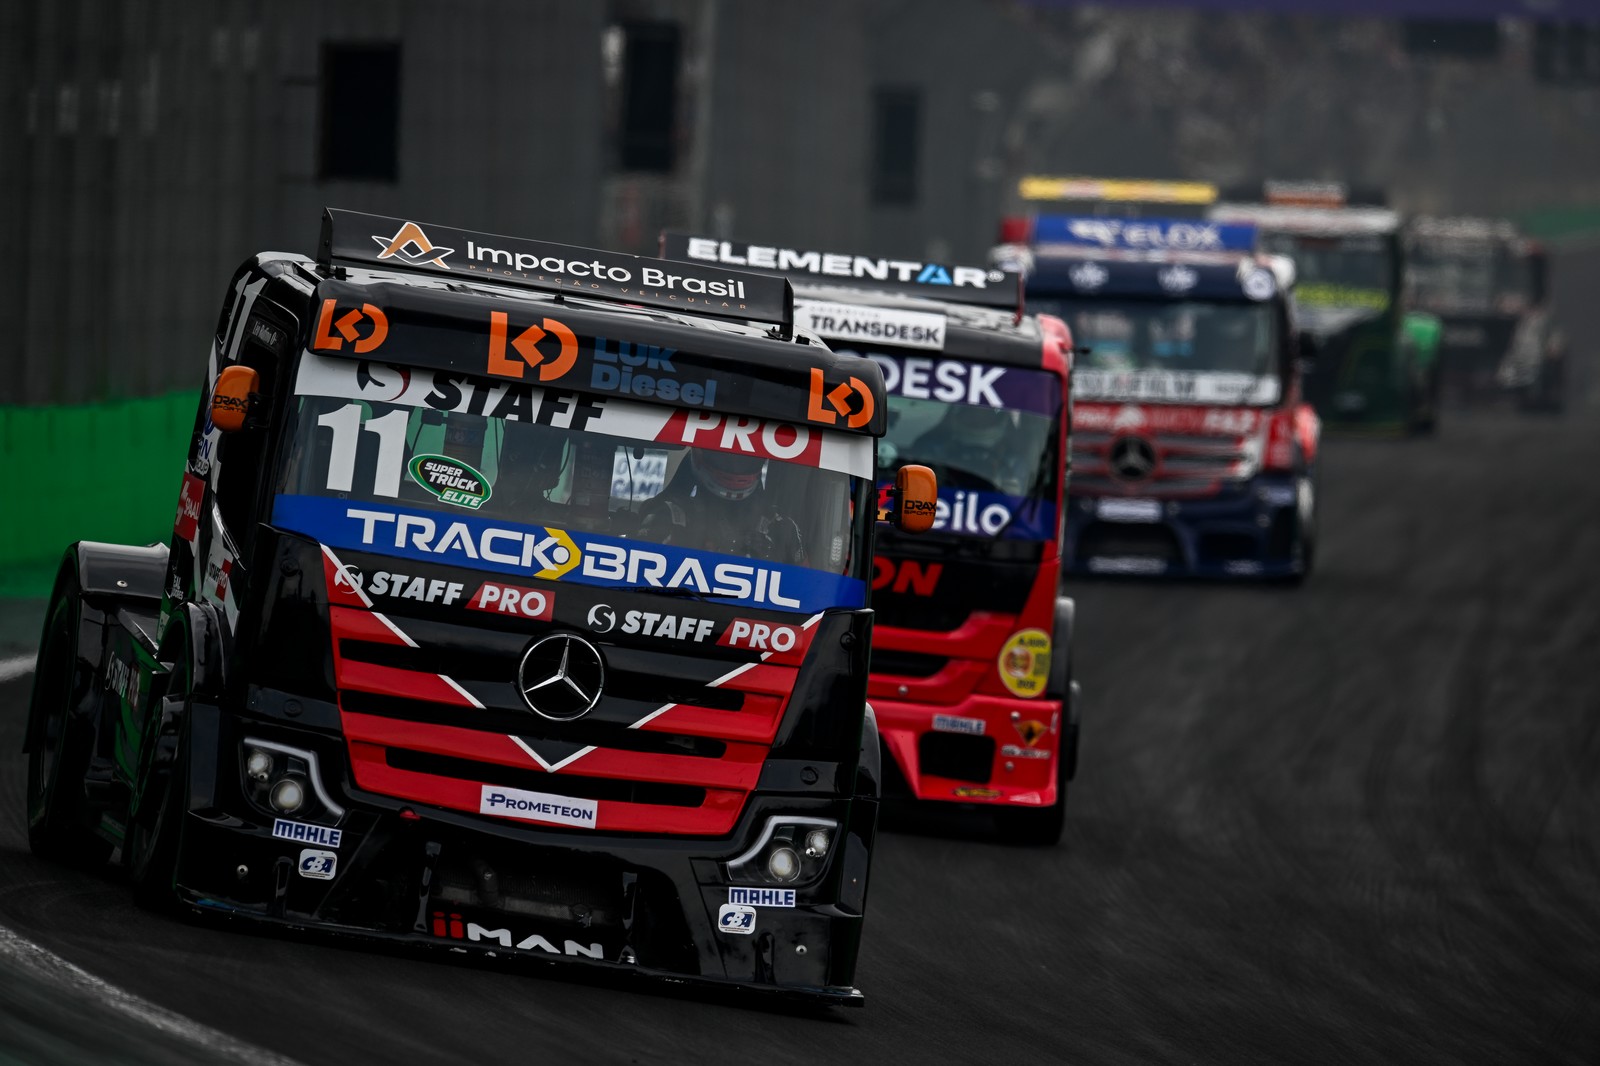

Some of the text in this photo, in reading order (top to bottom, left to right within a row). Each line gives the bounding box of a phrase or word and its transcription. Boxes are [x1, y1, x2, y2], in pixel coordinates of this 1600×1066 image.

[467, 241, 745, 299] Impacto Brasil
[621, 288, 747, 310] VEICULAR
[810, 314, 940, 343] TRANSDESK
[594, 336, 677, 372] LUK
[590, 362, 717, 408] Diesel
[214, 395, 248, 409] DRAX
[681, 409, 810, 459] PRO
[318, 403, 410, 499] 11
[424, 461, 463, 477] SUPER
[429, 471, 480, 492] TRUCK
[441, 489, 483, 507] ELITE
[905, 501, 937, 512] DRAX
[347, 508, 801, 609] TRACK BRASIL
[368, 571, 547, 617] STAFF PRO
[620, 610, 797, 652] STAFF PRO
[274, 820, 340, 846] MAHLE
[302, 856, 335, 873] CBA
[730, 888, 794, 906] MAHLE
[721, 911, 754, 928] CBA
